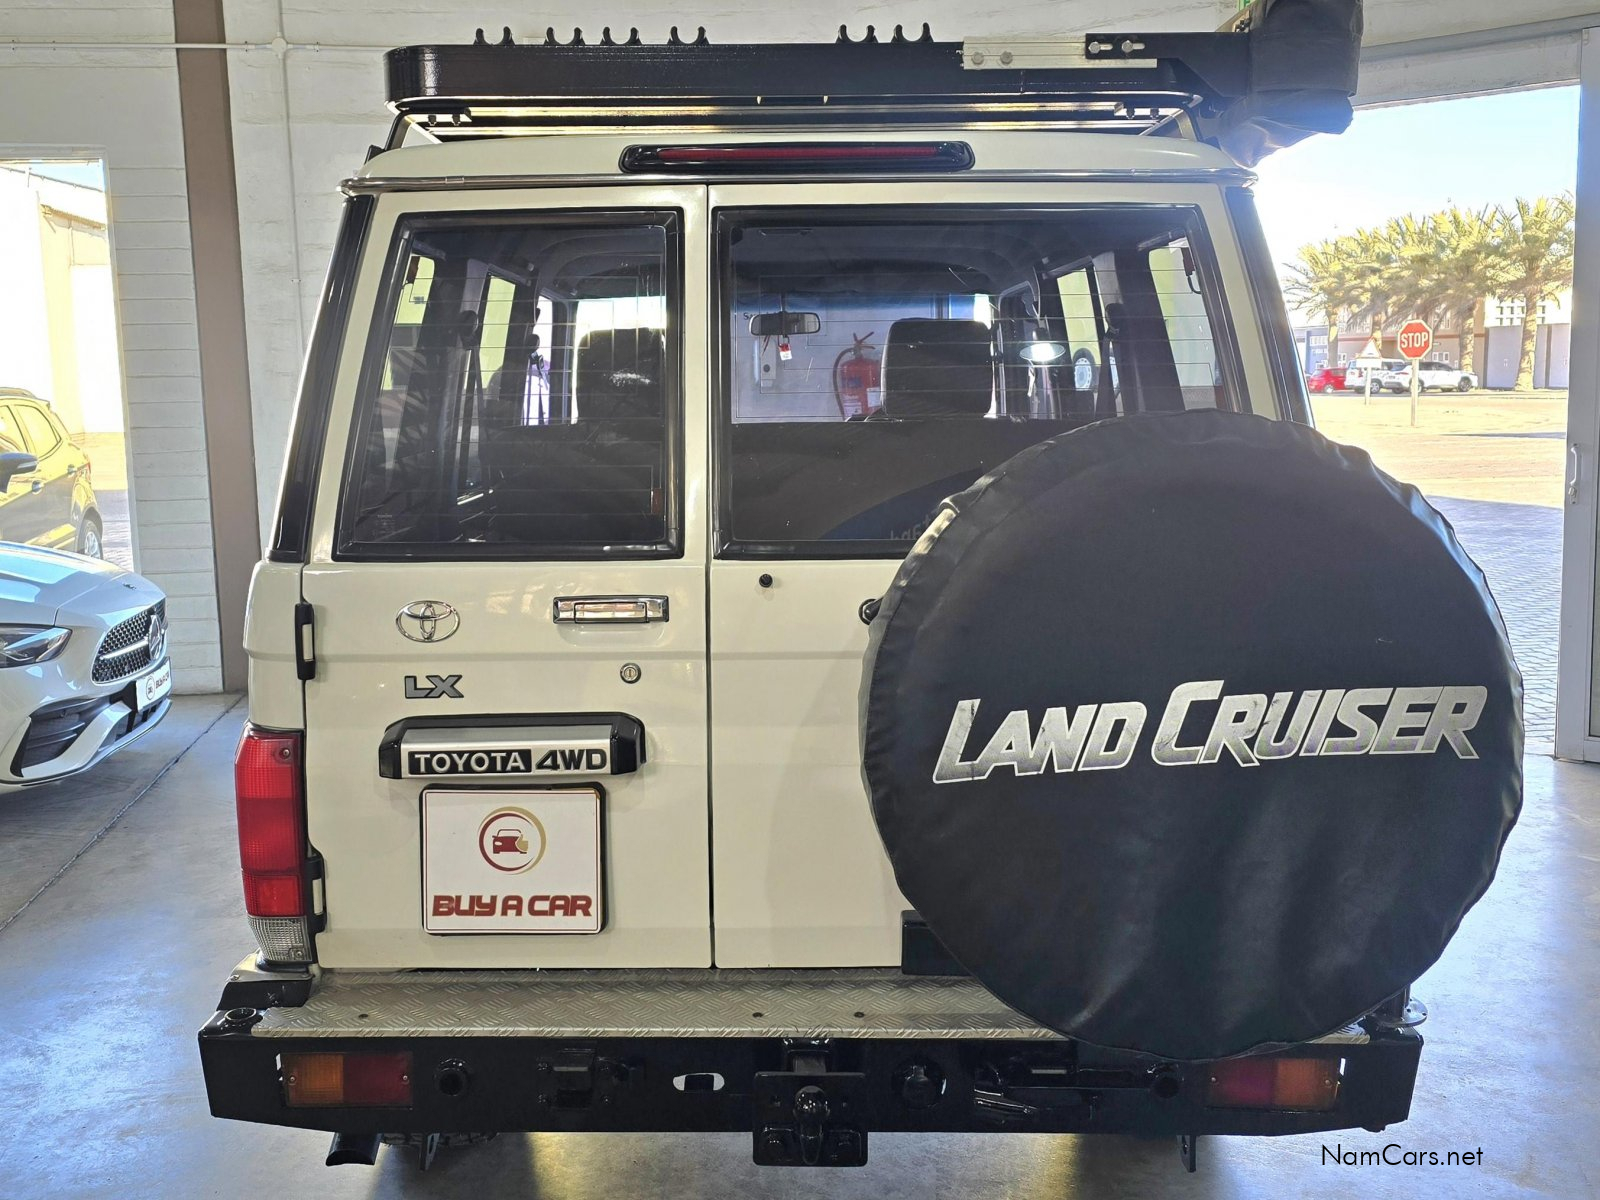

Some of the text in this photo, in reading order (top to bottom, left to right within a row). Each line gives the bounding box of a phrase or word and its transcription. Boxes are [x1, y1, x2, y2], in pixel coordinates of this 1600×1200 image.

[1400, 332, 1428, 348] STOP
[404, 674, 464, 699] LX
[932, 680, 1488, 784] LAND CRUISER
[414, 749, 608, 773] TOYOTA 4WD
[432, 894, 593, 917] BUY A CAR
